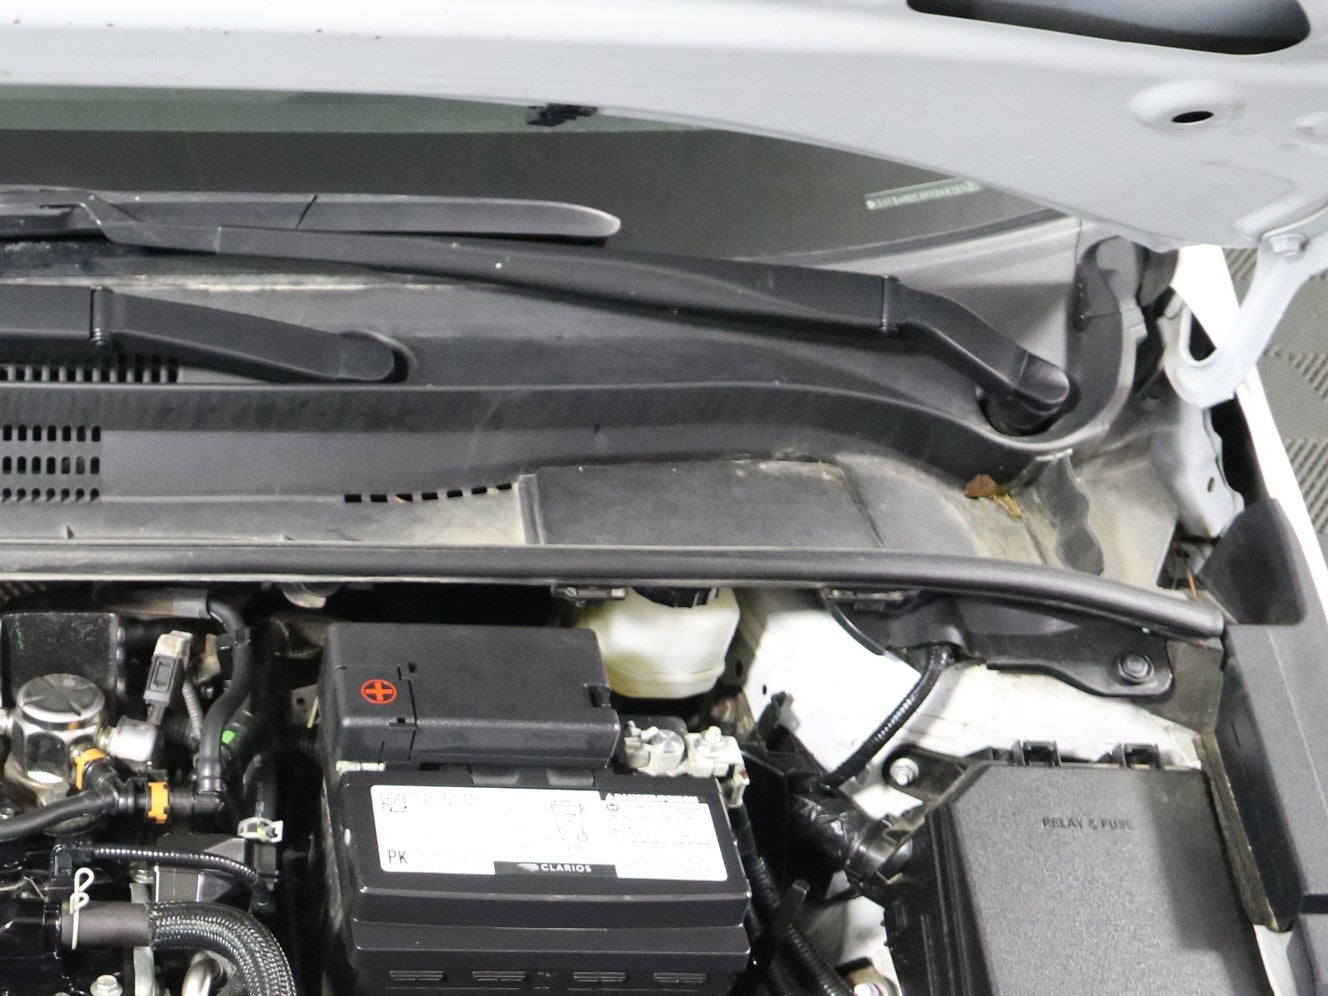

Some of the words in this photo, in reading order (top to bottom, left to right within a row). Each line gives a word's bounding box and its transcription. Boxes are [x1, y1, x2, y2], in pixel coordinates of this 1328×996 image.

[1042, 817, 1084, 831] RELAY
[1101, 818, 1133, 831] FUSE
[388, 850, 408, 864] PK
[540, 863, 592, 873] CLARIOS
